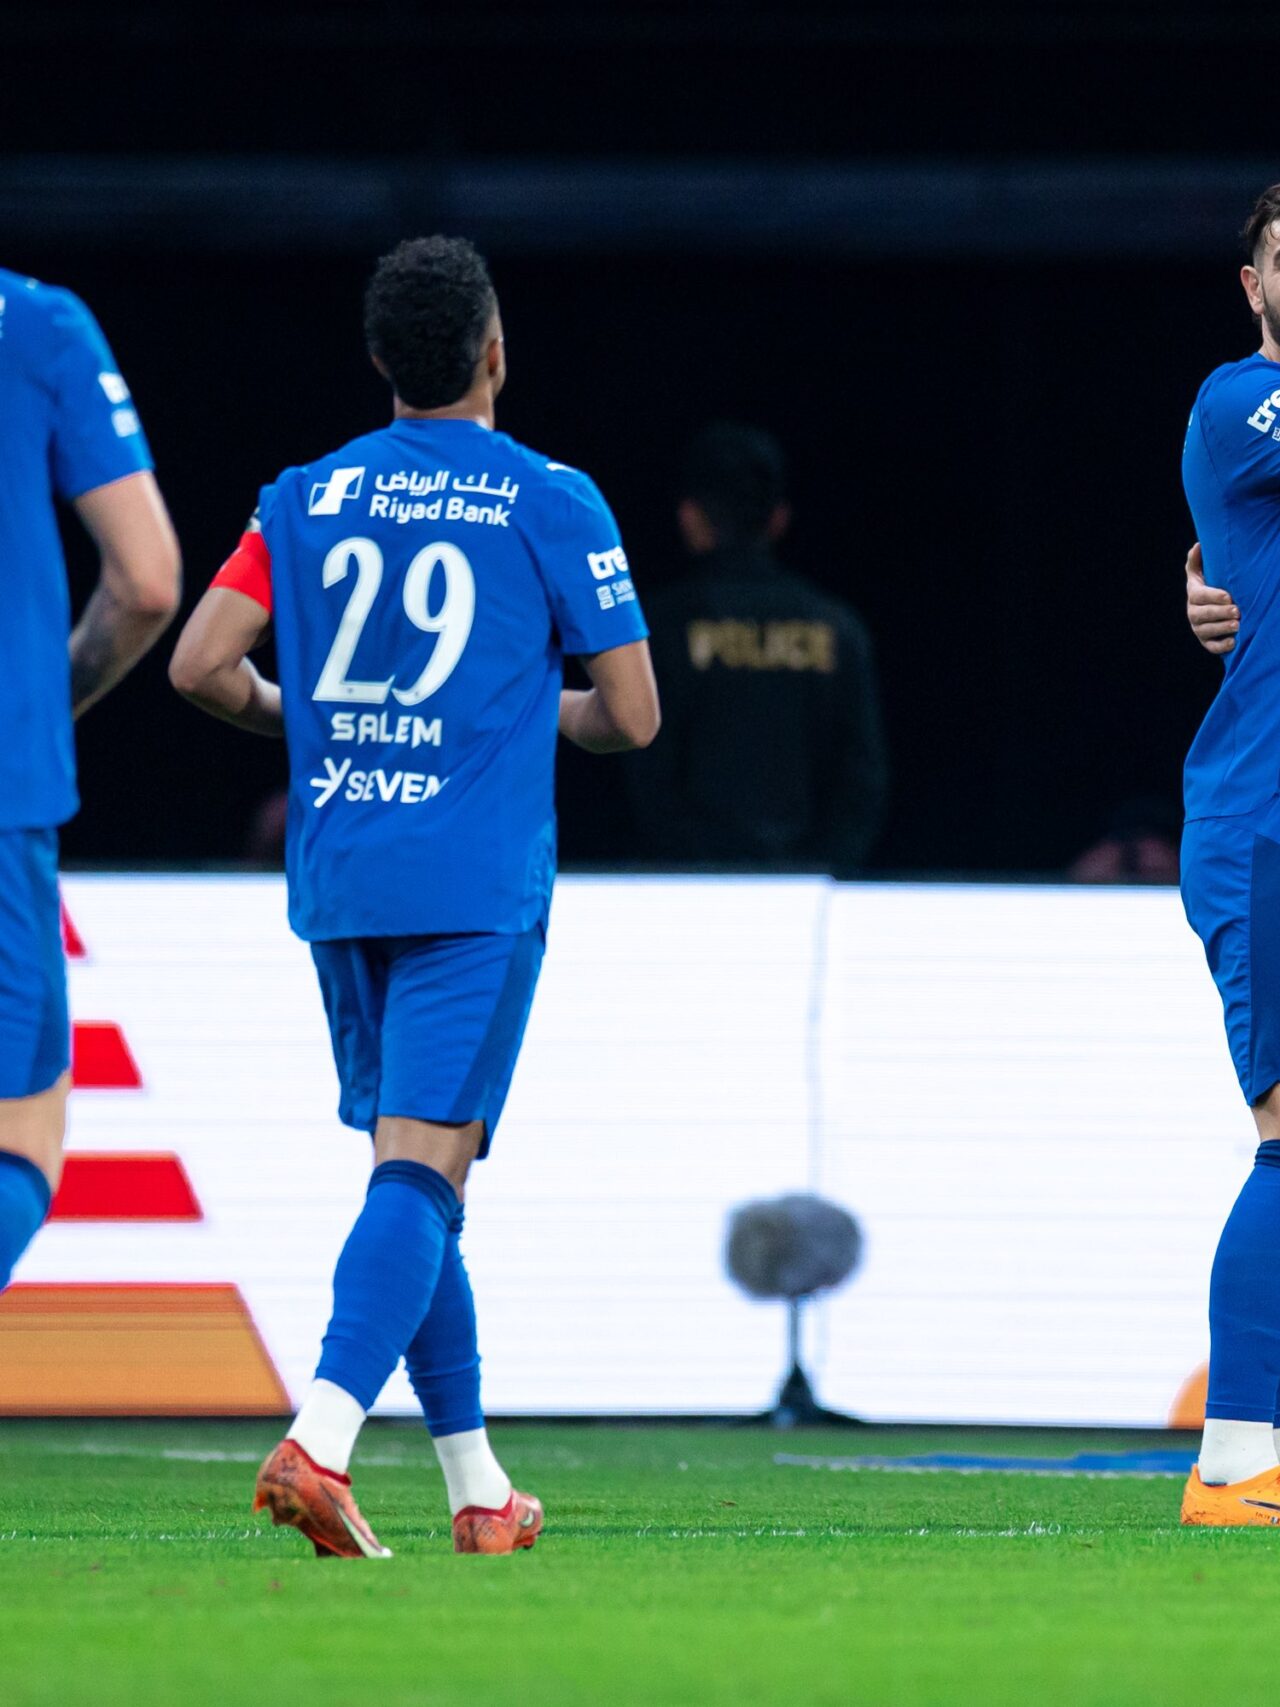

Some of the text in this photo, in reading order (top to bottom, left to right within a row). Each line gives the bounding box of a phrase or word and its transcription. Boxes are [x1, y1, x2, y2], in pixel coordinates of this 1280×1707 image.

[374, 470, 520, 504] بنك الرياض
[368, 494, 512, 528] Riyad Bank
[587, 545, 629, 580] tre
[311, 536, 477, 707] 29
[330, 710, 443, 749] SALEM
